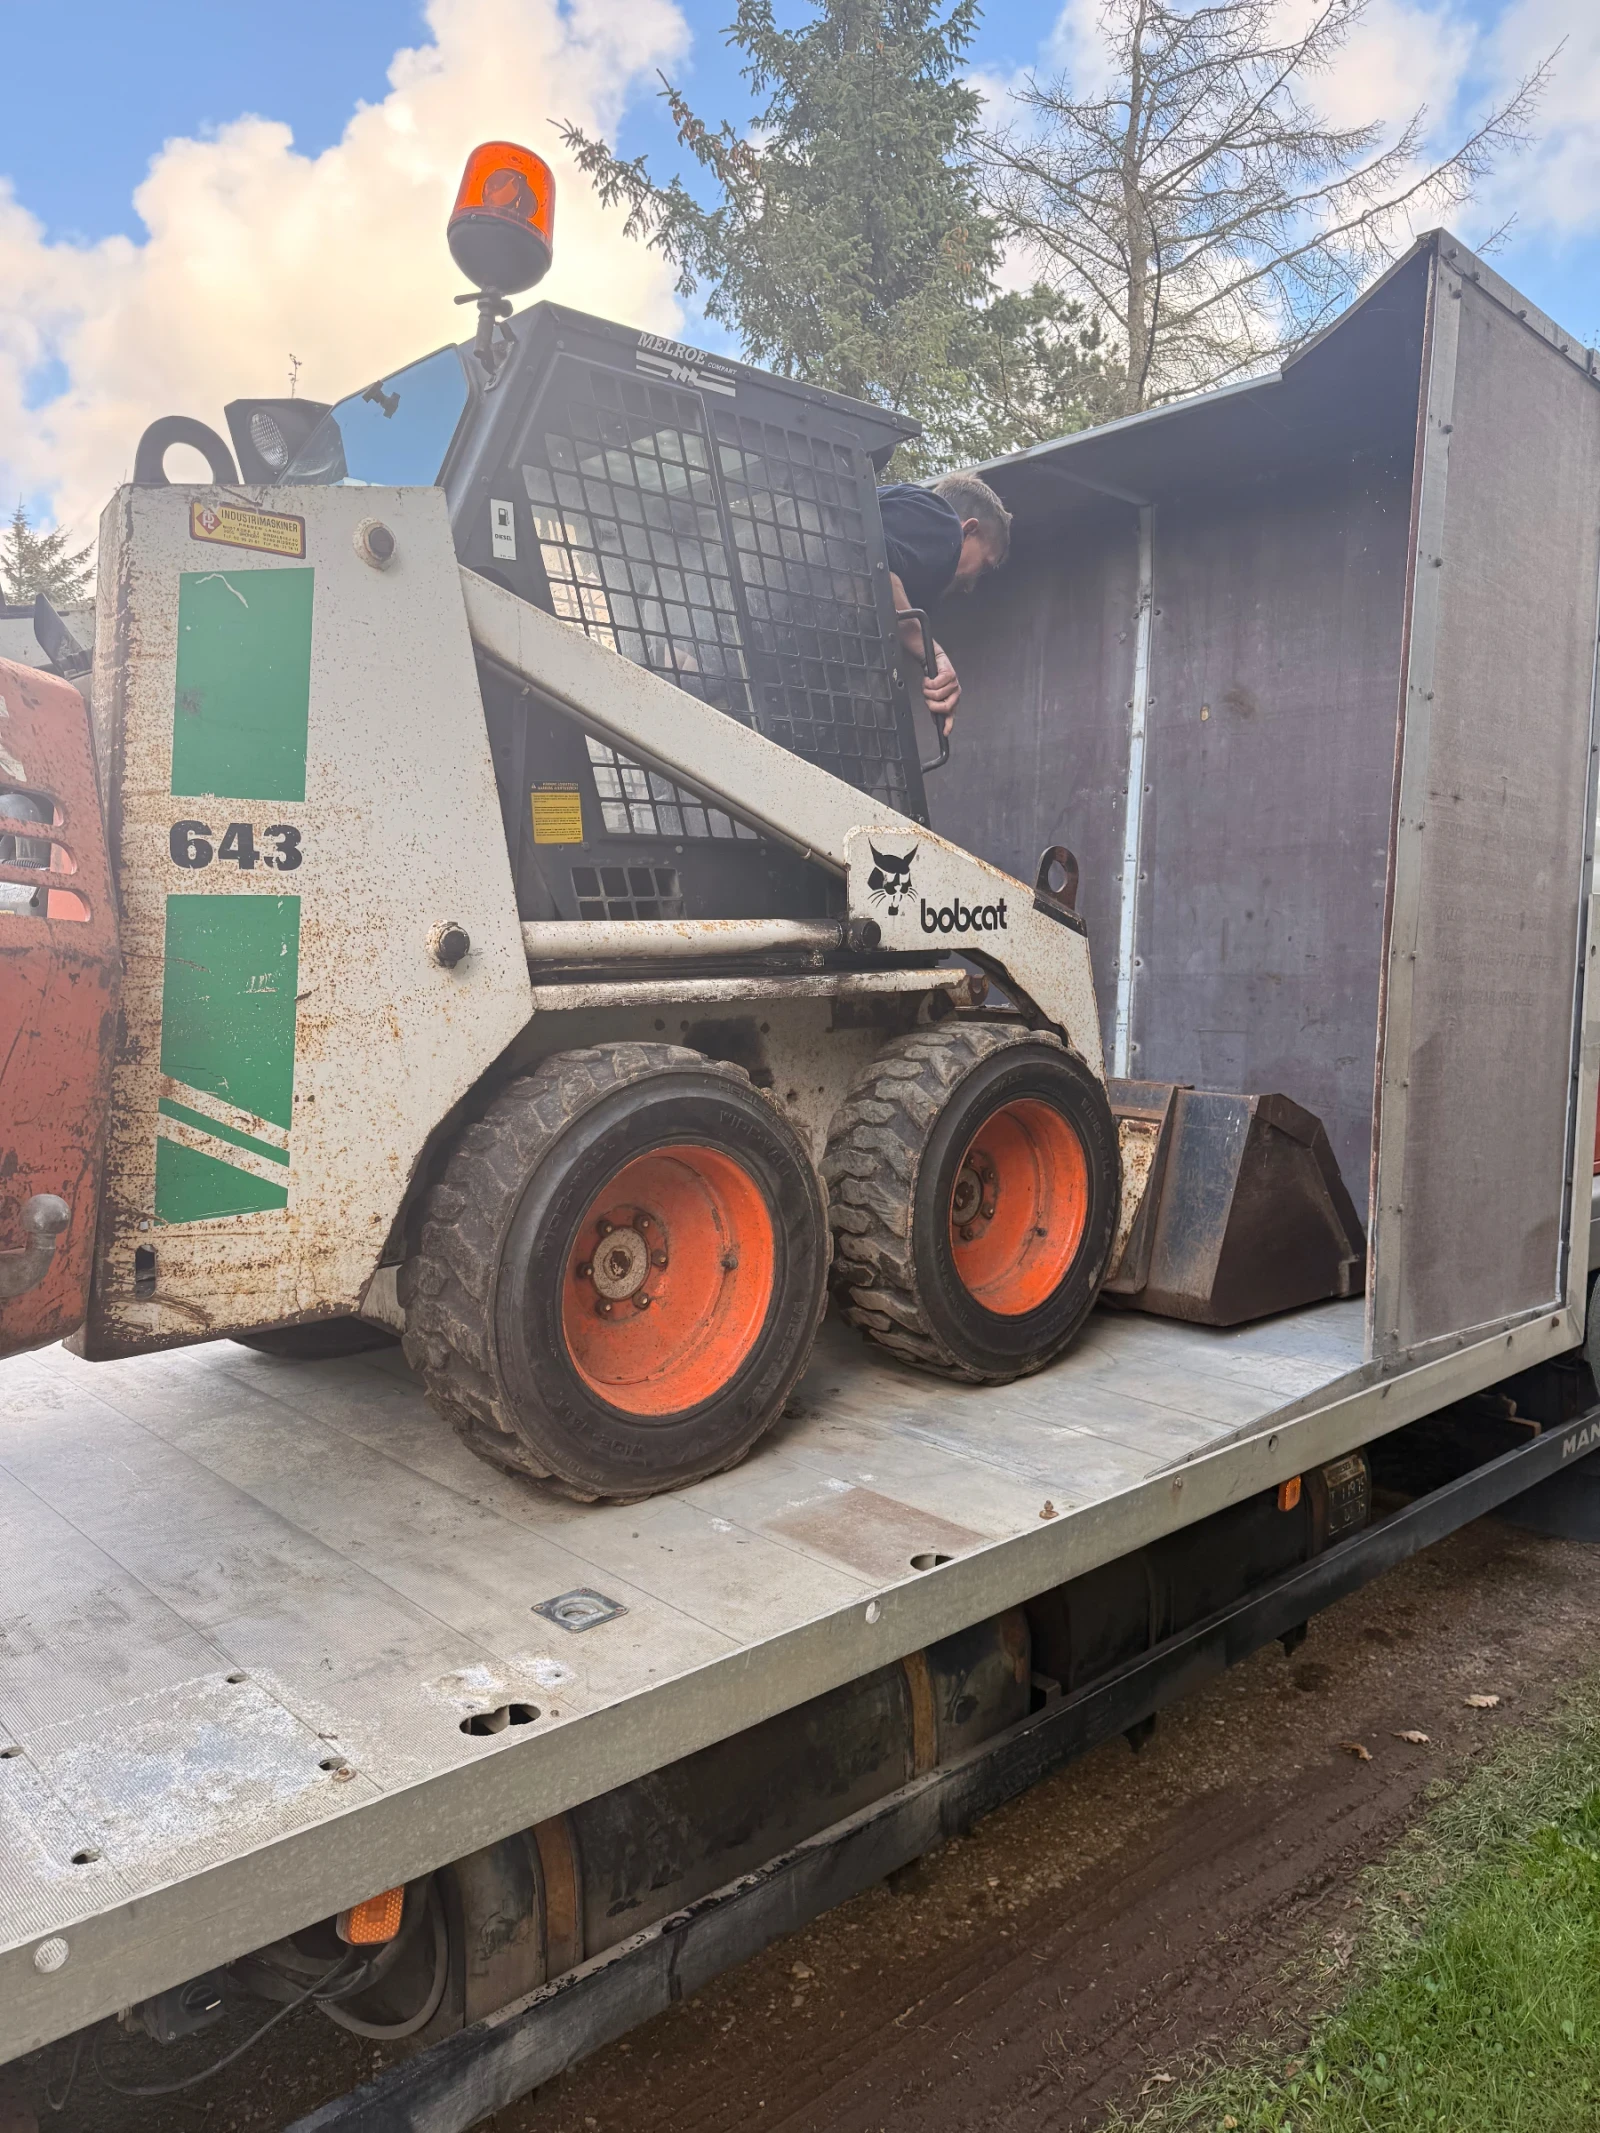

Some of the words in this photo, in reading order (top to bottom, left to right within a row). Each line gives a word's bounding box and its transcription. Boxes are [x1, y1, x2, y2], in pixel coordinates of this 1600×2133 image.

[637, 331, 709, 366] MELROE
[707, 361, 738, 376] COMPANY
[221, 509, 298, 533] INDUSTRIMASKINER
[494, 533, 513, 542] DIESEL
[169, 819, 303, 872] 643
[920, 897, 1008, 934] bobcat
[1562, 1420, 1600, 1459] MAN
